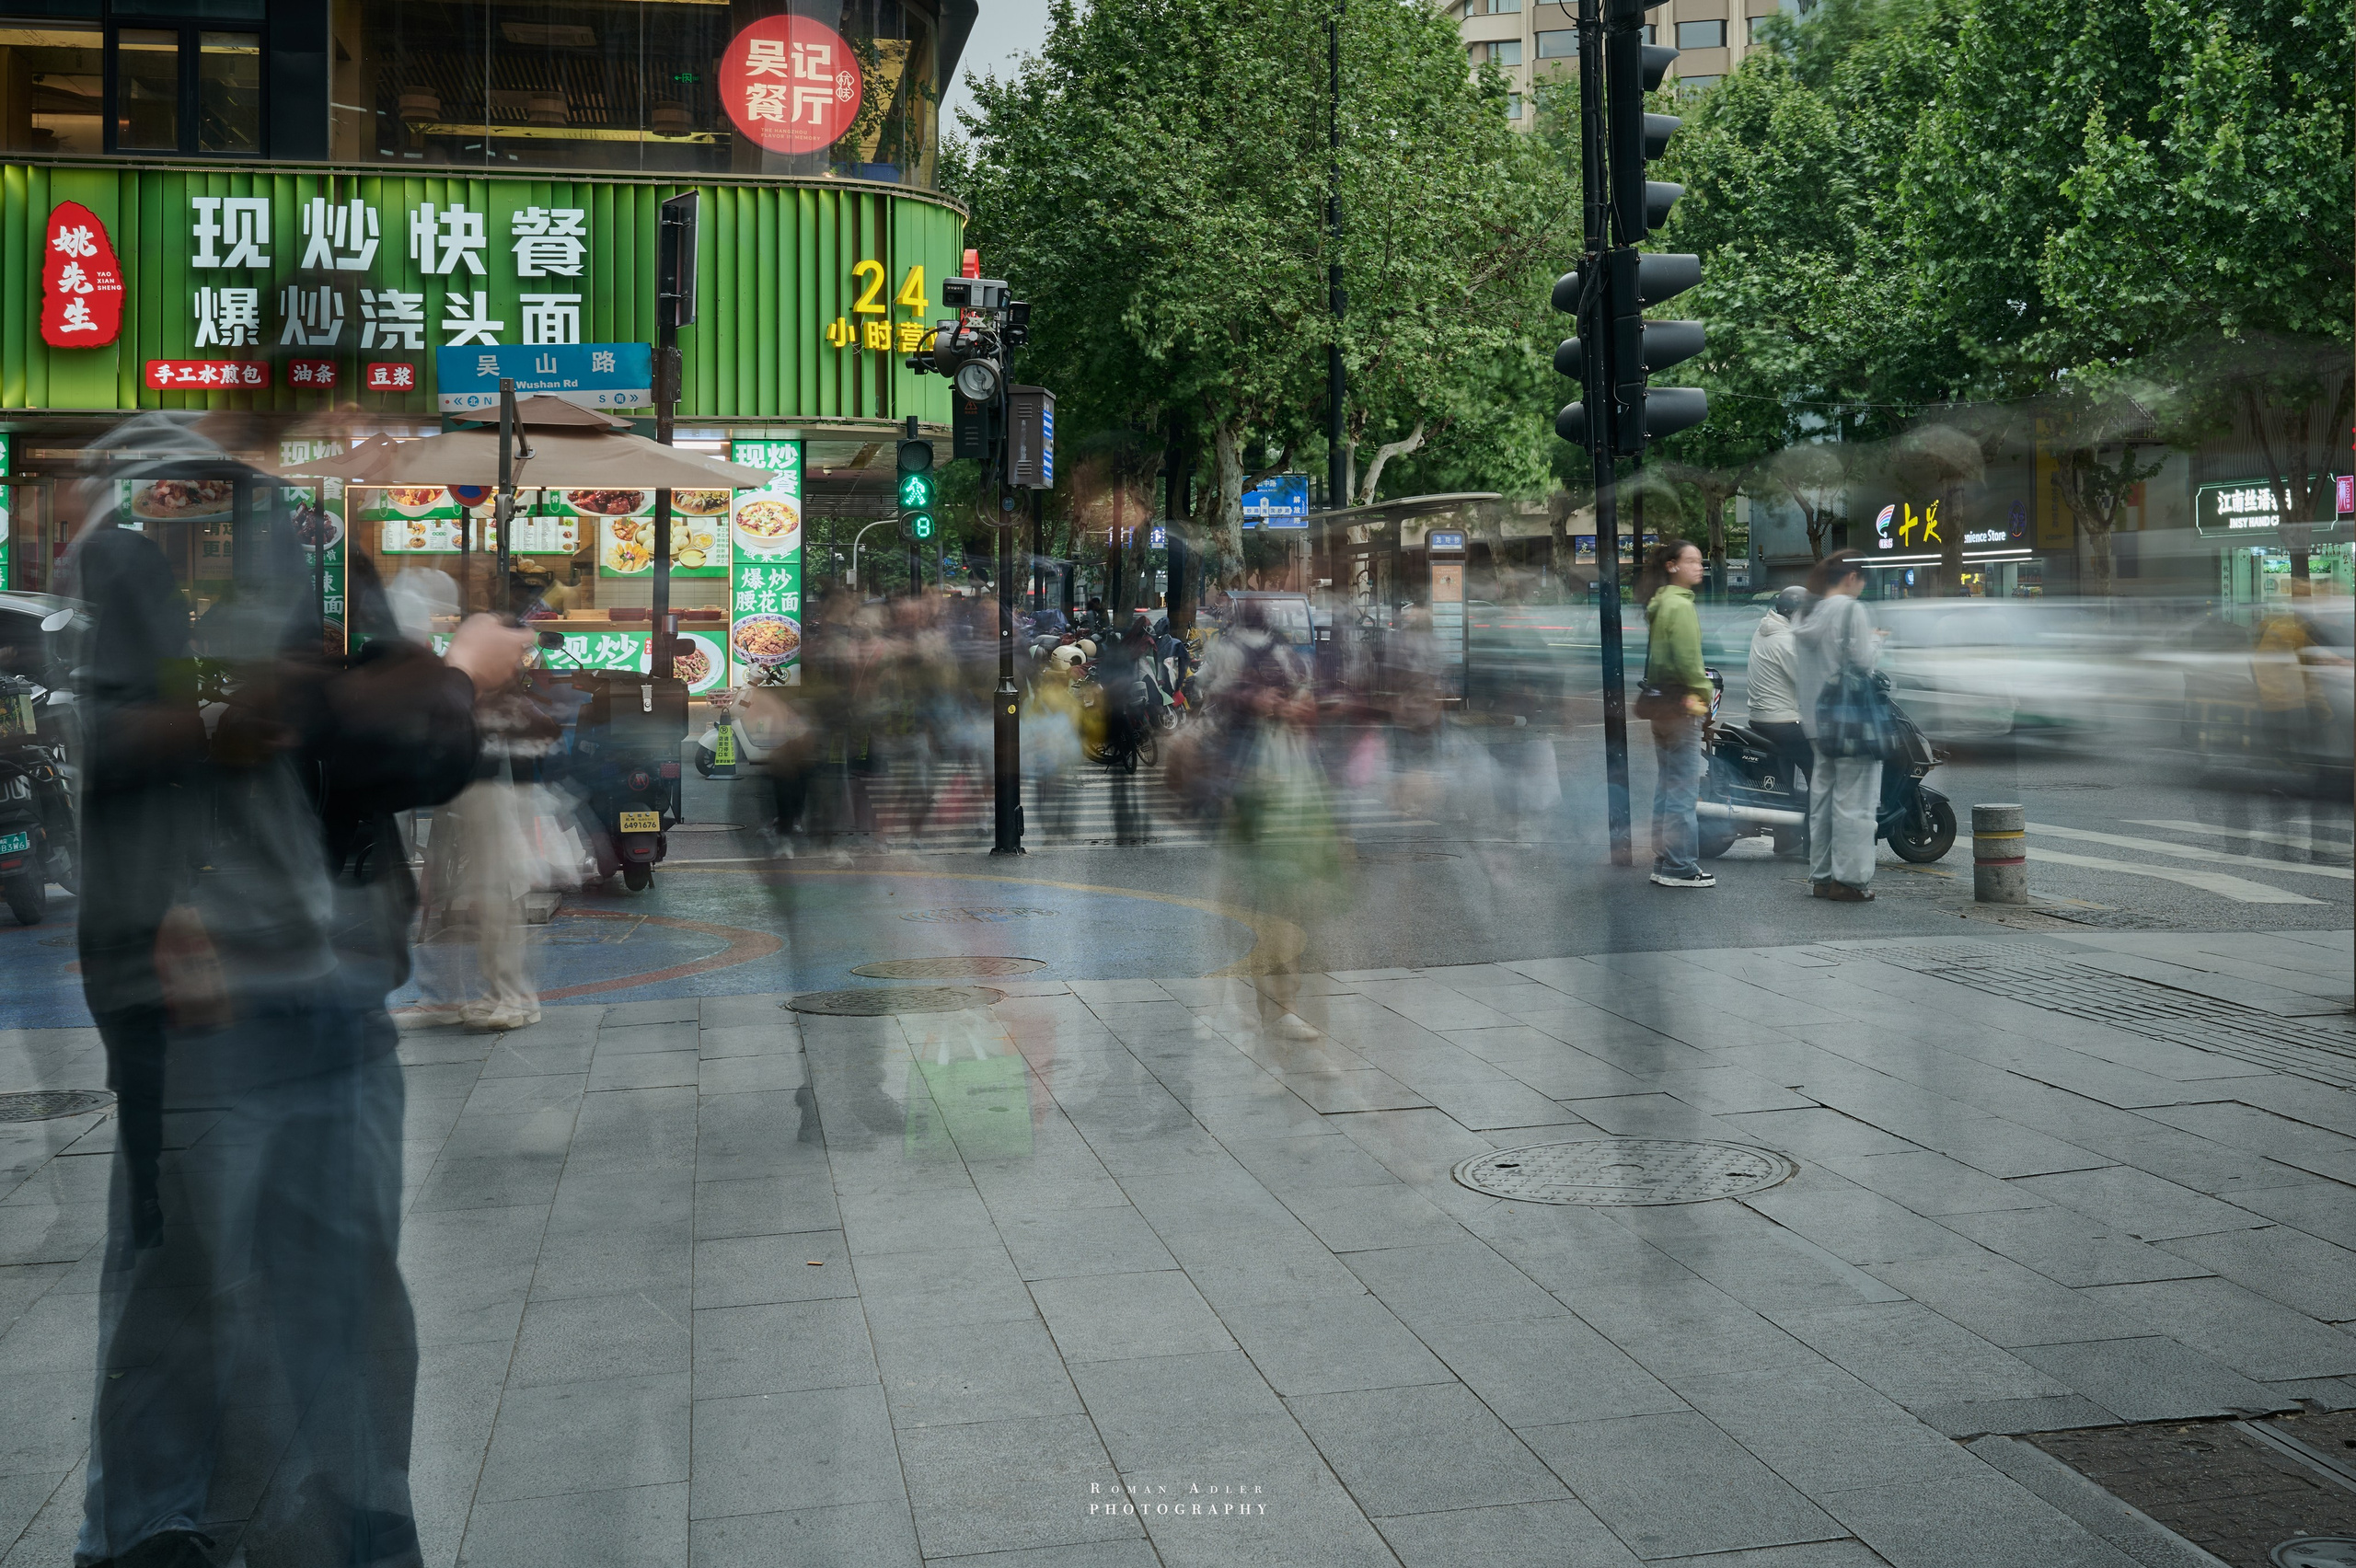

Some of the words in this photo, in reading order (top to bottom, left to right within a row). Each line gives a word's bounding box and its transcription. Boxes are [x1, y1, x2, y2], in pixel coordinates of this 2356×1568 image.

[745, 39, 834, 82] 吴记
[837, 74, 851, 99] 杭味
[745, 83, 834, 125] 餐厅
[191, 196, 587, 278] 现炒快餐
[52, 225, 98, 333] 姚先生
[852, 259, 929, 317] 24
[194, 285, 582, 350] 爆炒浇头面
[154, 363, 262, 385] 手工水煎包
[293, 364, 336, 382] 油条
[370, 367, 413, 386] 豆浆
[476, 351, 616, 377] 吴山路
[515, 380, 559, 389] Wushan
[563, 379, 579, 388] Rd
[468, 395, 478, 406] 北
[484, 398, 492, 406] N
[598, 395, 606, 404] S
[615, 394, 625, 404] 南
[734, 443, 800, 469] 现炒
[2217, 489, 2292, 515] 江南丝语
[1899, 499, 1942, 547] 十足
[2249, 515, 2270, 528] HAND
[1987, 529, 2006, 542] Store
[741, 567, 793, 592] 爆炒
[733, 590, 800, 613] 腰花面
[549, 634, 640, 666] 现炒
[624, 821, 656, 829] 6491676
